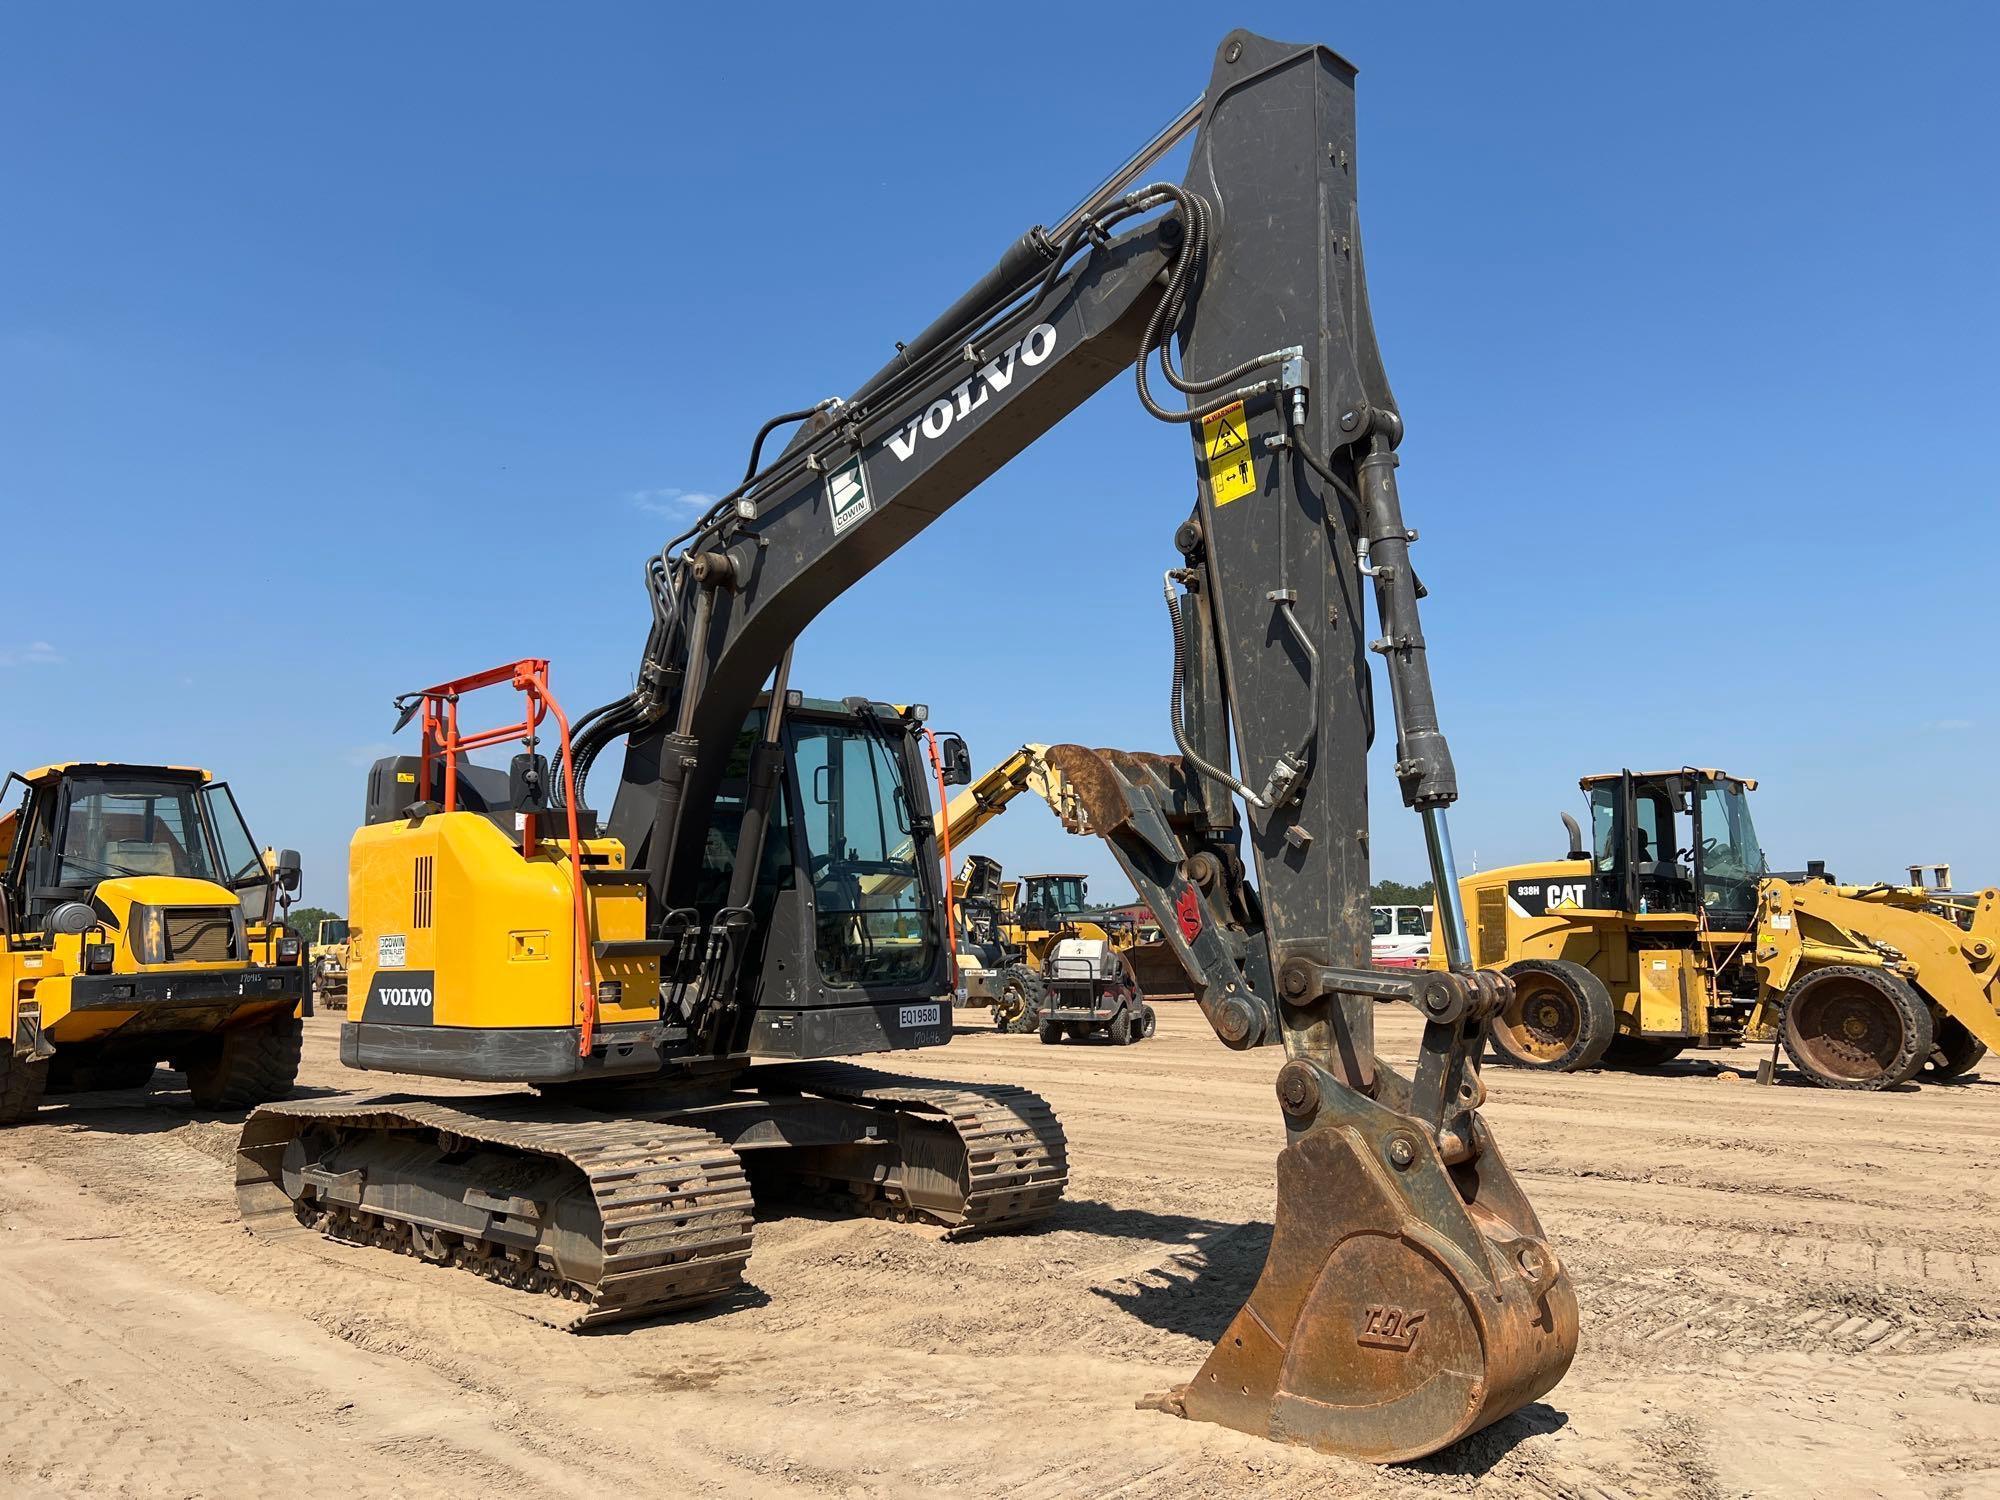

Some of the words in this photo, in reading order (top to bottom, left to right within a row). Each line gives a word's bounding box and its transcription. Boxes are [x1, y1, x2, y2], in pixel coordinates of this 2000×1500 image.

[883, 323, 1057, 462] VOLVO
[1211, 403, 1242, 420] WARNING
[837, 500, 865, 526] COWIN
[960, 862, 973, 881] CAT
[1517, 886, 1540, 896] 938H
[1547, 884, 1587, 909] CAT
[385, 937, 405, 947] COWIN
[379, 988, 432, 1006] VOLVO
[901, 1008, 938, 1024] EQ19580
